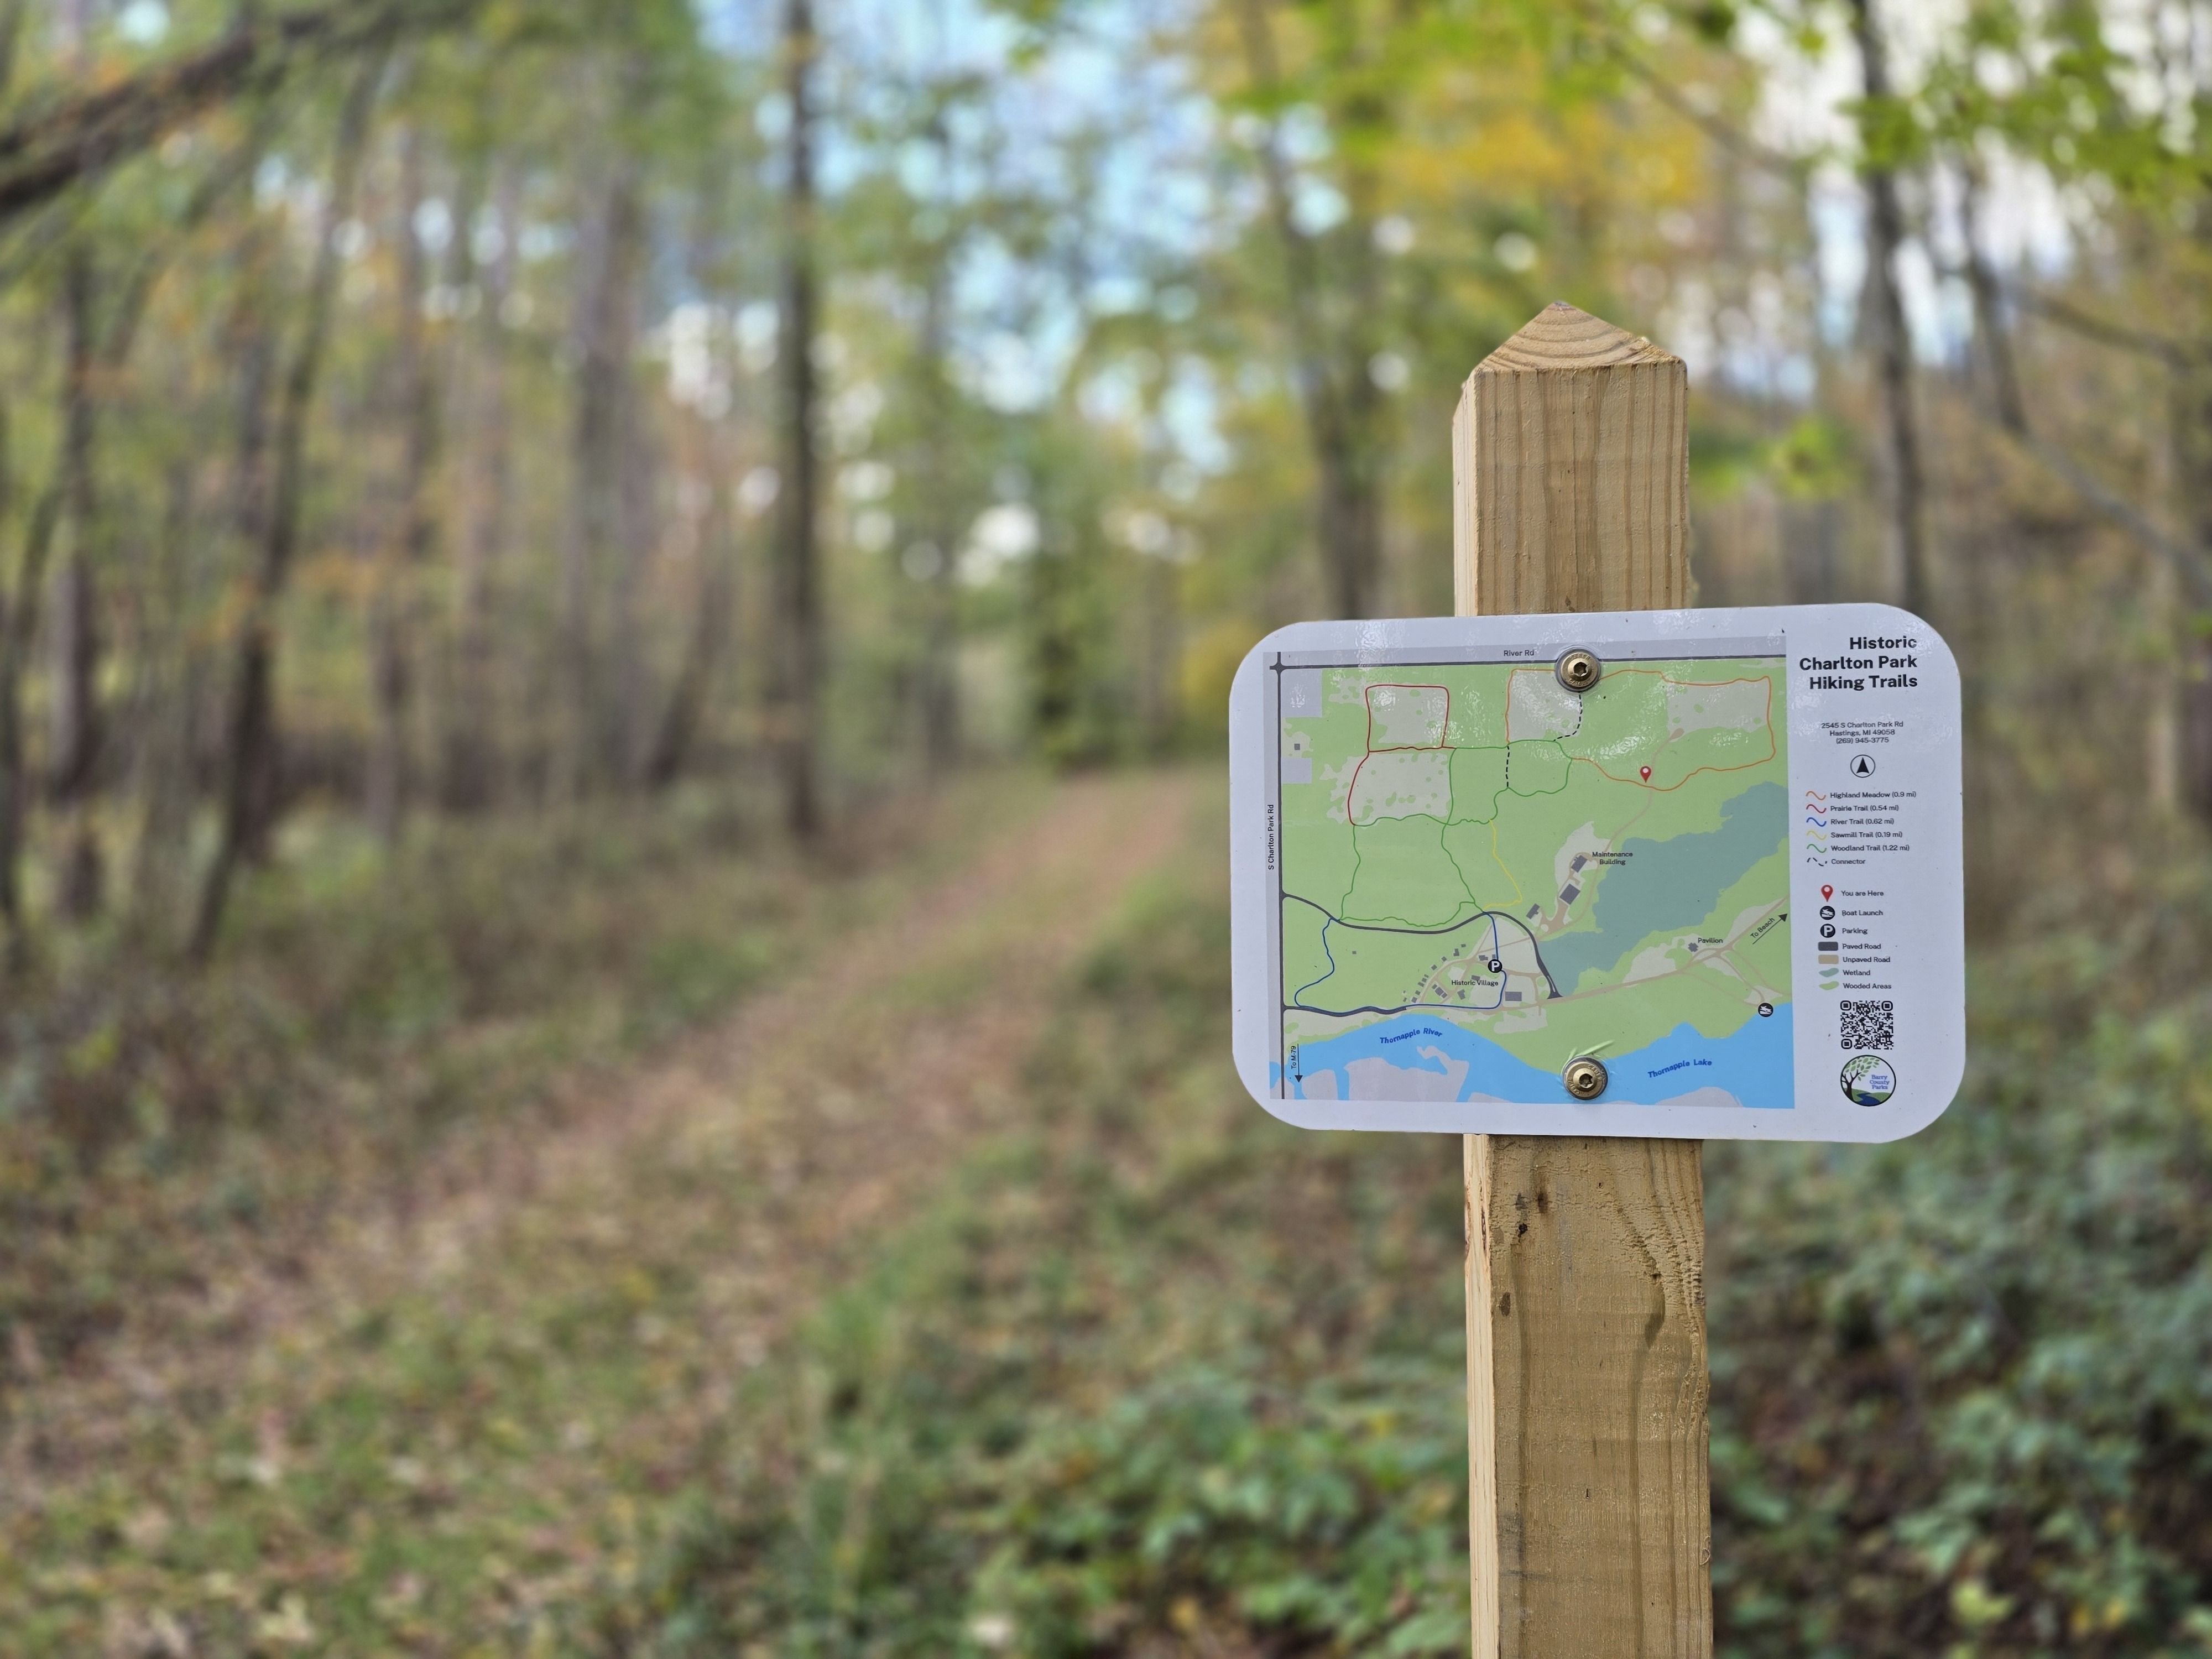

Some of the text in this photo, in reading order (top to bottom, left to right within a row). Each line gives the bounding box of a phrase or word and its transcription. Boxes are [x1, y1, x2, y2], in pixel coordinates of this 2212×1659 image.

[1850, 636, 1917, 649] Historic
[1799, 655, 1917, 670] Charlton Park
[1810, 674, 1918, 691] Hiking Trails
[1267, 805, 1274, 813] Rd
[1757, 917, 1775, 932] Beach
[1824, 925, 1833, 936] P
[1491, 961, 1500, 971] P
[1380, 1028, 1442, 1044] Thornapple River
[1647, 1060, 1690, 1078] Thornapple
